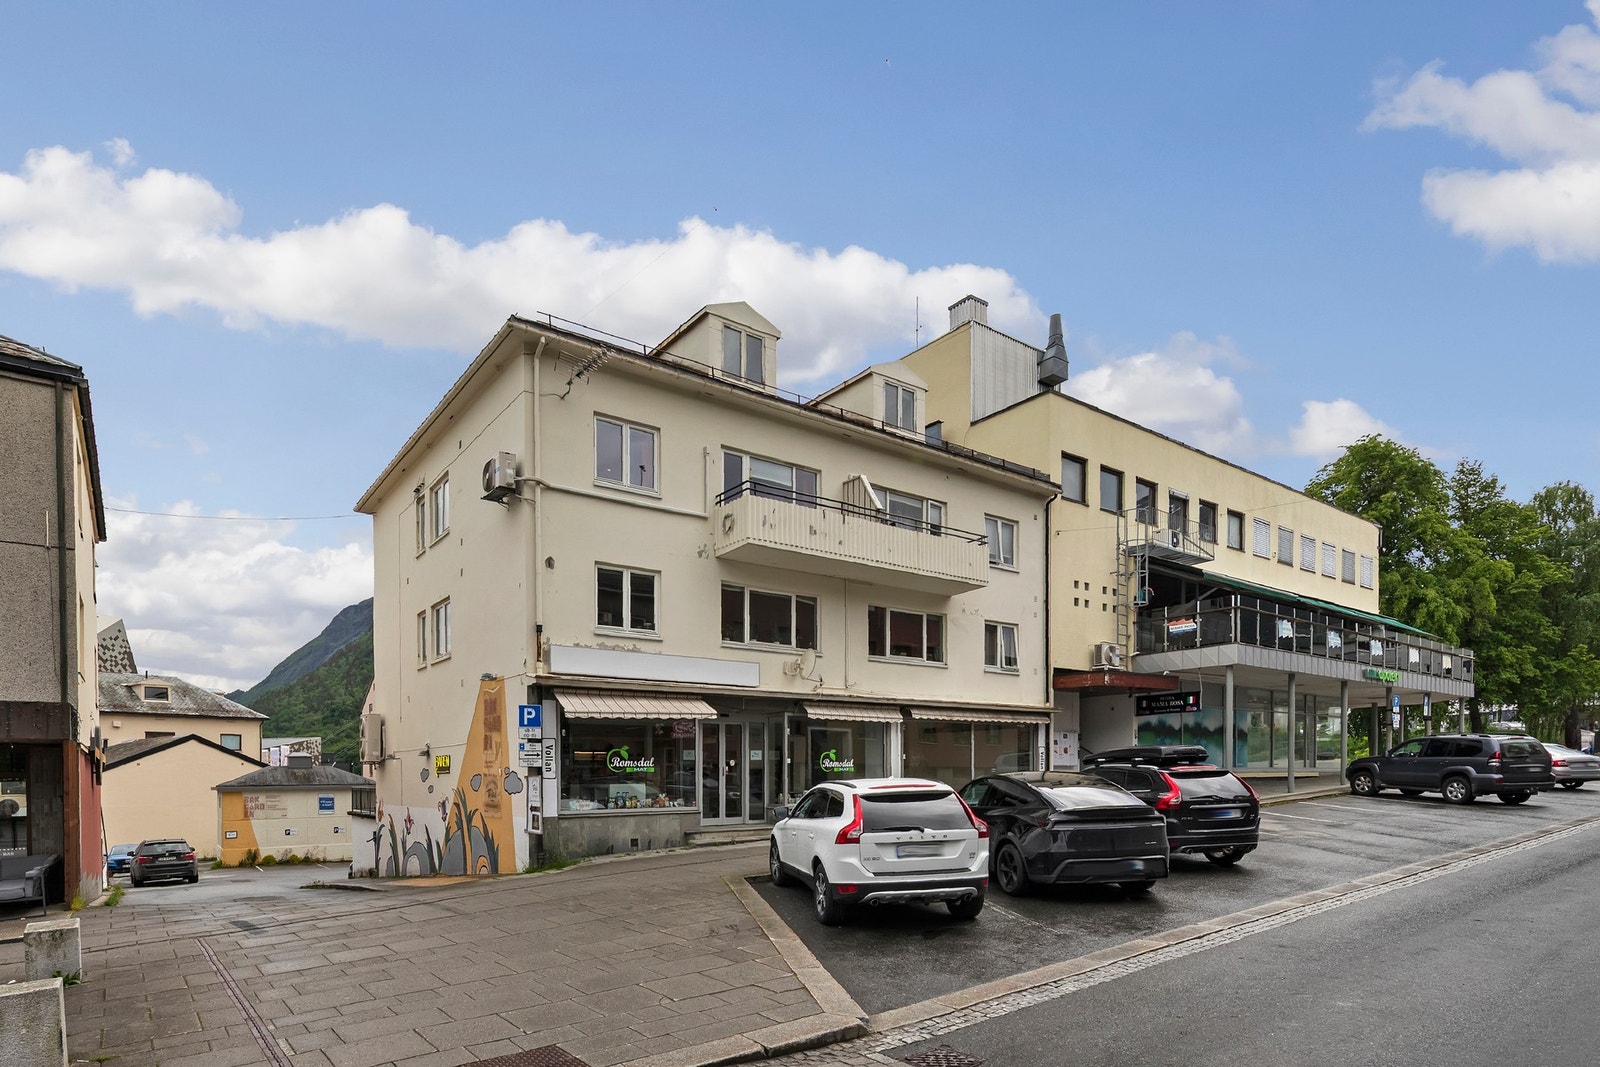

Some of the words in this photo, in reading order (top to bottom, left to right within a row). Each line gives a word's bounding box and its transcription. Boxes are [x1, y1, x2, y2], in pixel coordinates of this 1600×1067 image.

[523, 707, 536, 725] P
[544, 744, 554, 773] Vollan
[610, 756, 655, 767] Romsdal
[822, 758, 854, 768] Romsdal
